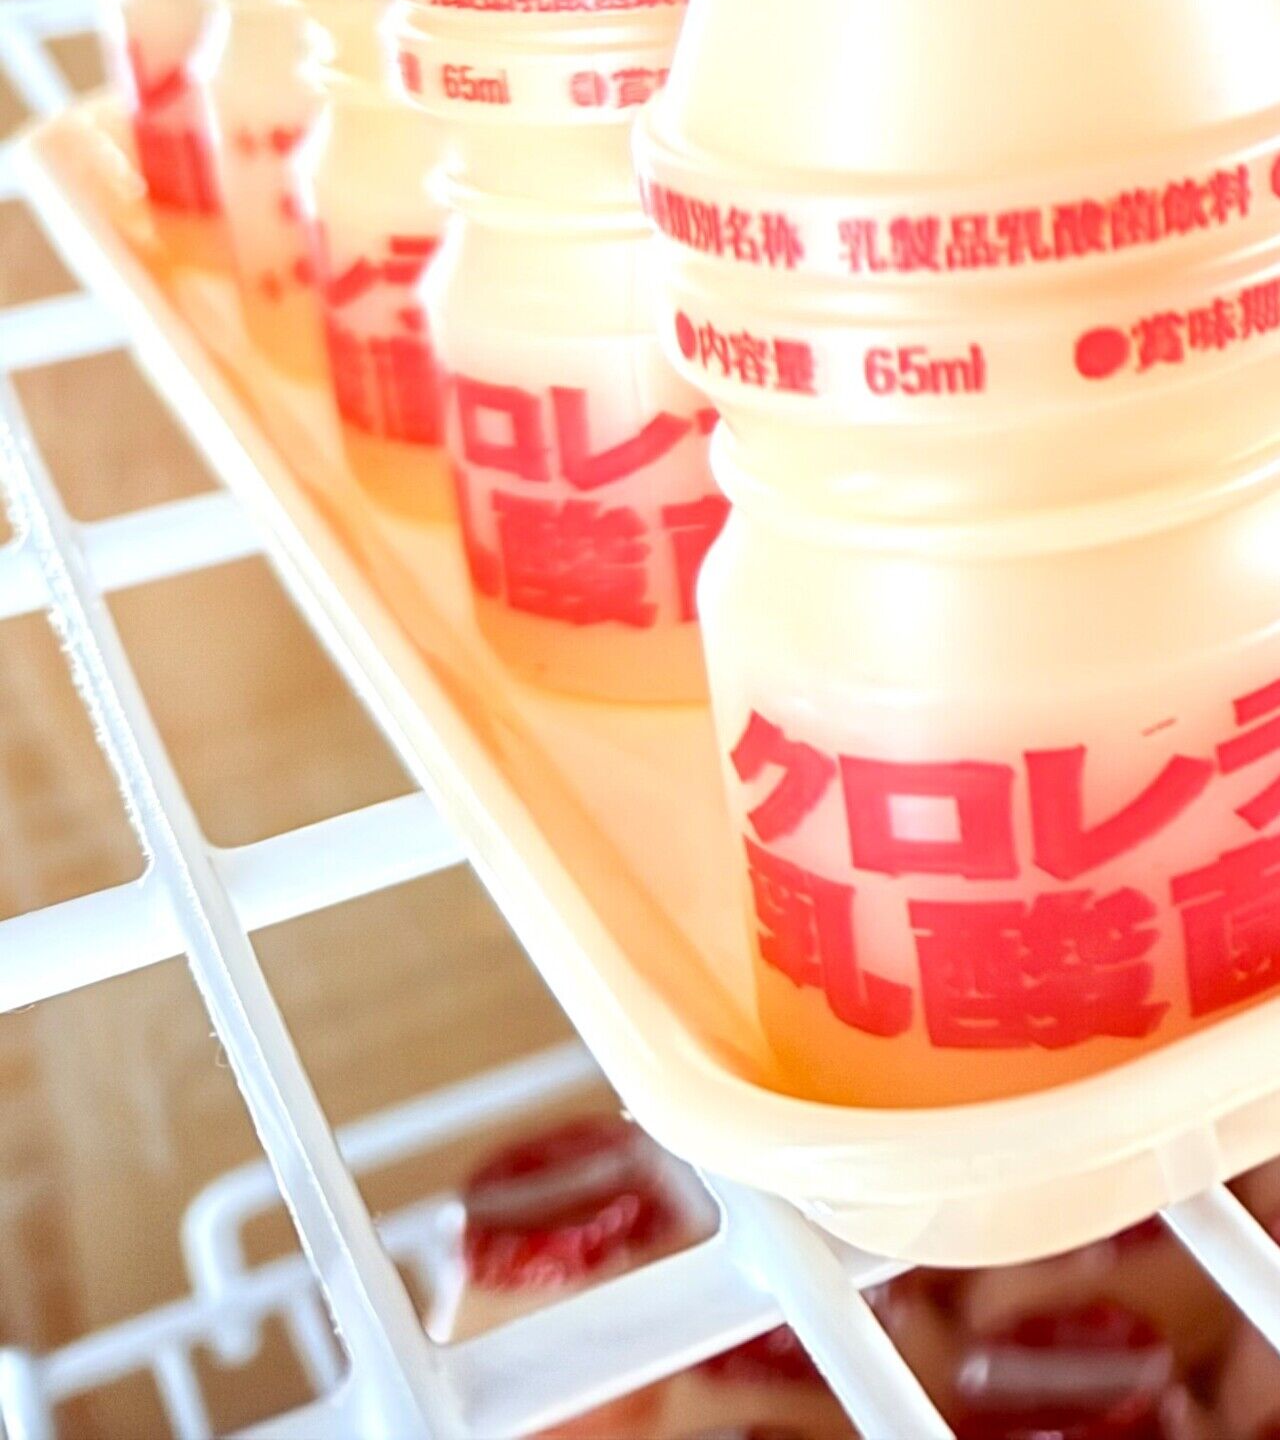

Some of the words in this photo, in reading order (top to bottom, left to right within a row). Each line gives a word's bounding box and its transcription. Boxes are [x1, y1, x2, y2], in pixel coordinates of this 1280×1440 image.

[837, 162, 1252, 274] 乳製品乳酸菌飲料
[697, 317, 818, 397] 内容量
[863, 341, 988, 397] 65ml
[452, 374, 720, 492] ロレ
